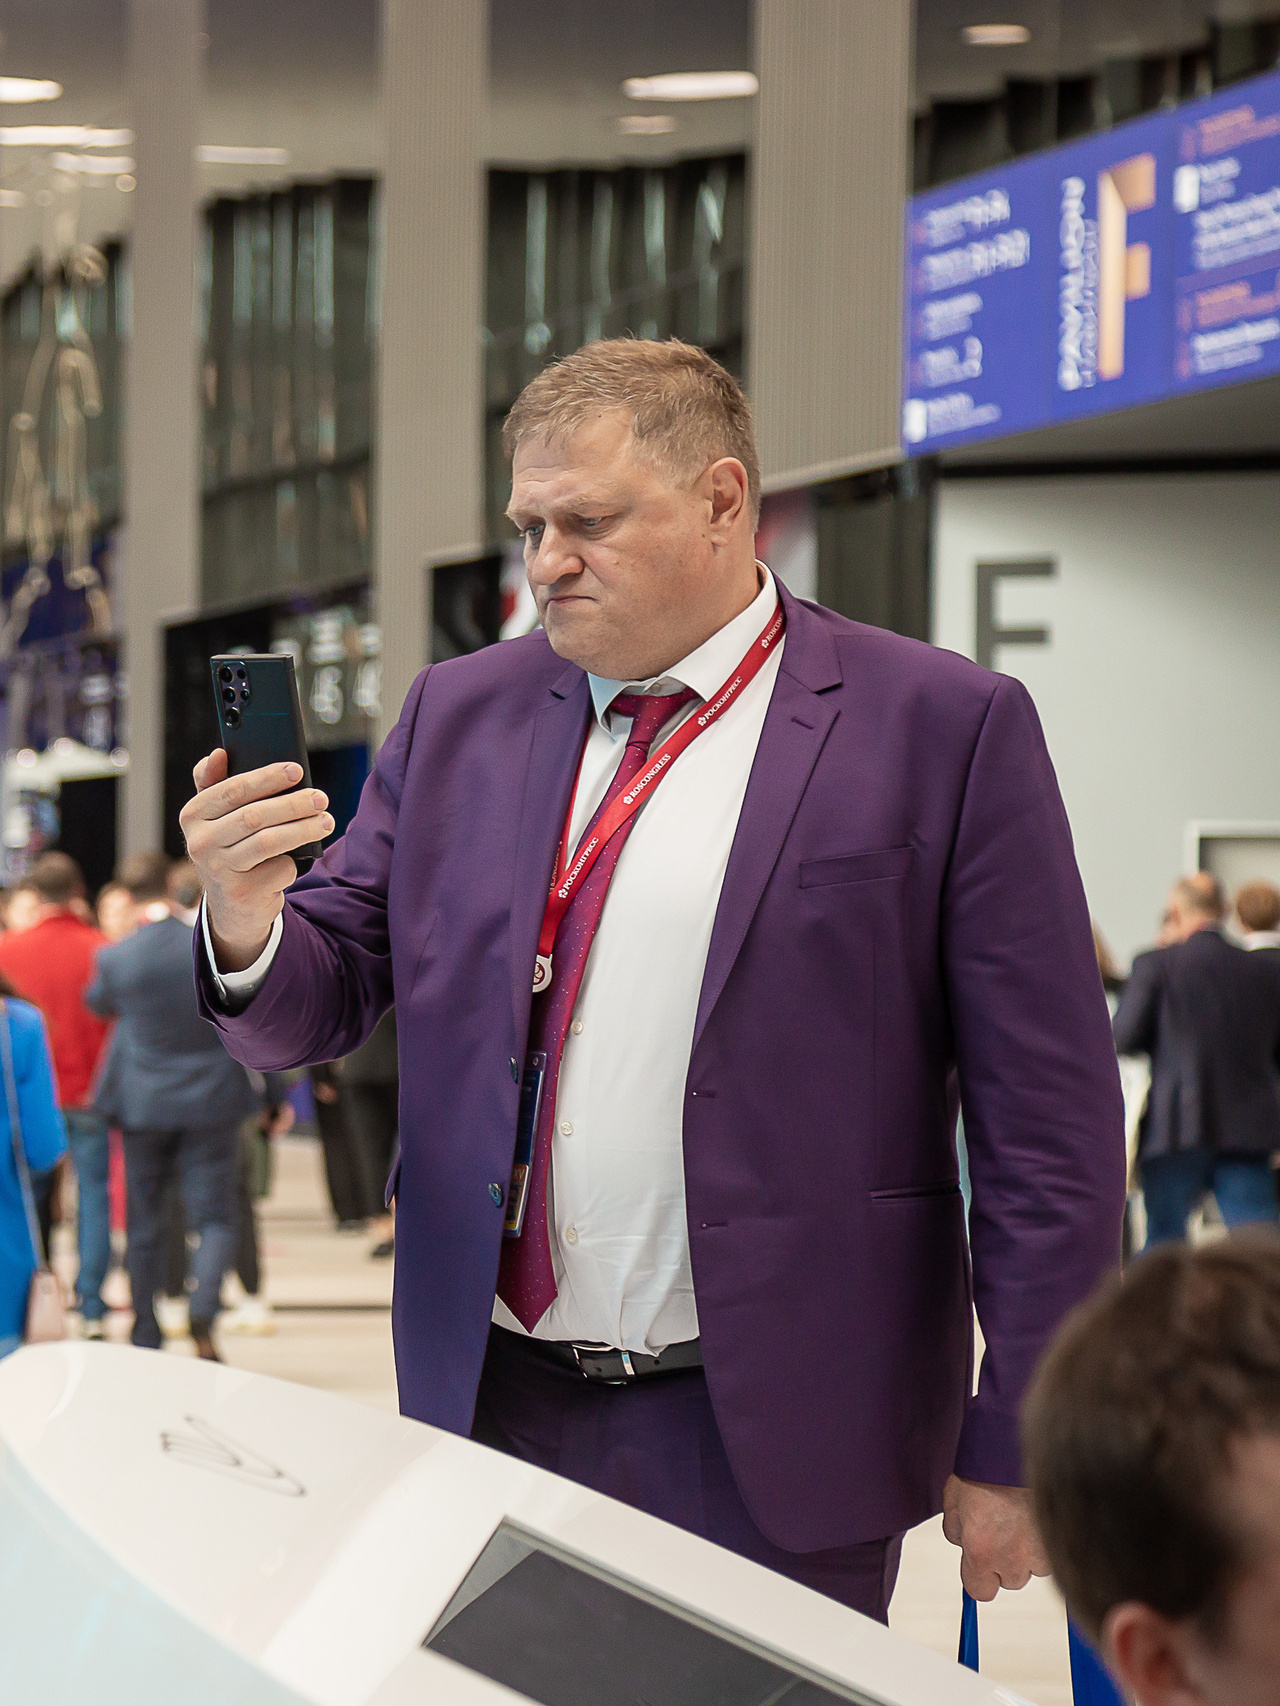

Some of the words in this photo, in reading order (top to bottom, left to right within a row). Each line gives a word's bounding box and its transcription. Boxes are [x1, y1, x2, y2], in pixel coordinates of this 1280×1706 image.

[975, 560, 1055, 671] F
[704, 676, 742, 720] РОСКОНГРЕСС
[629, 753, 671, 798] ROSCONGRESS
[562, 837, 599, 890] РОСКОНГРЕСС
